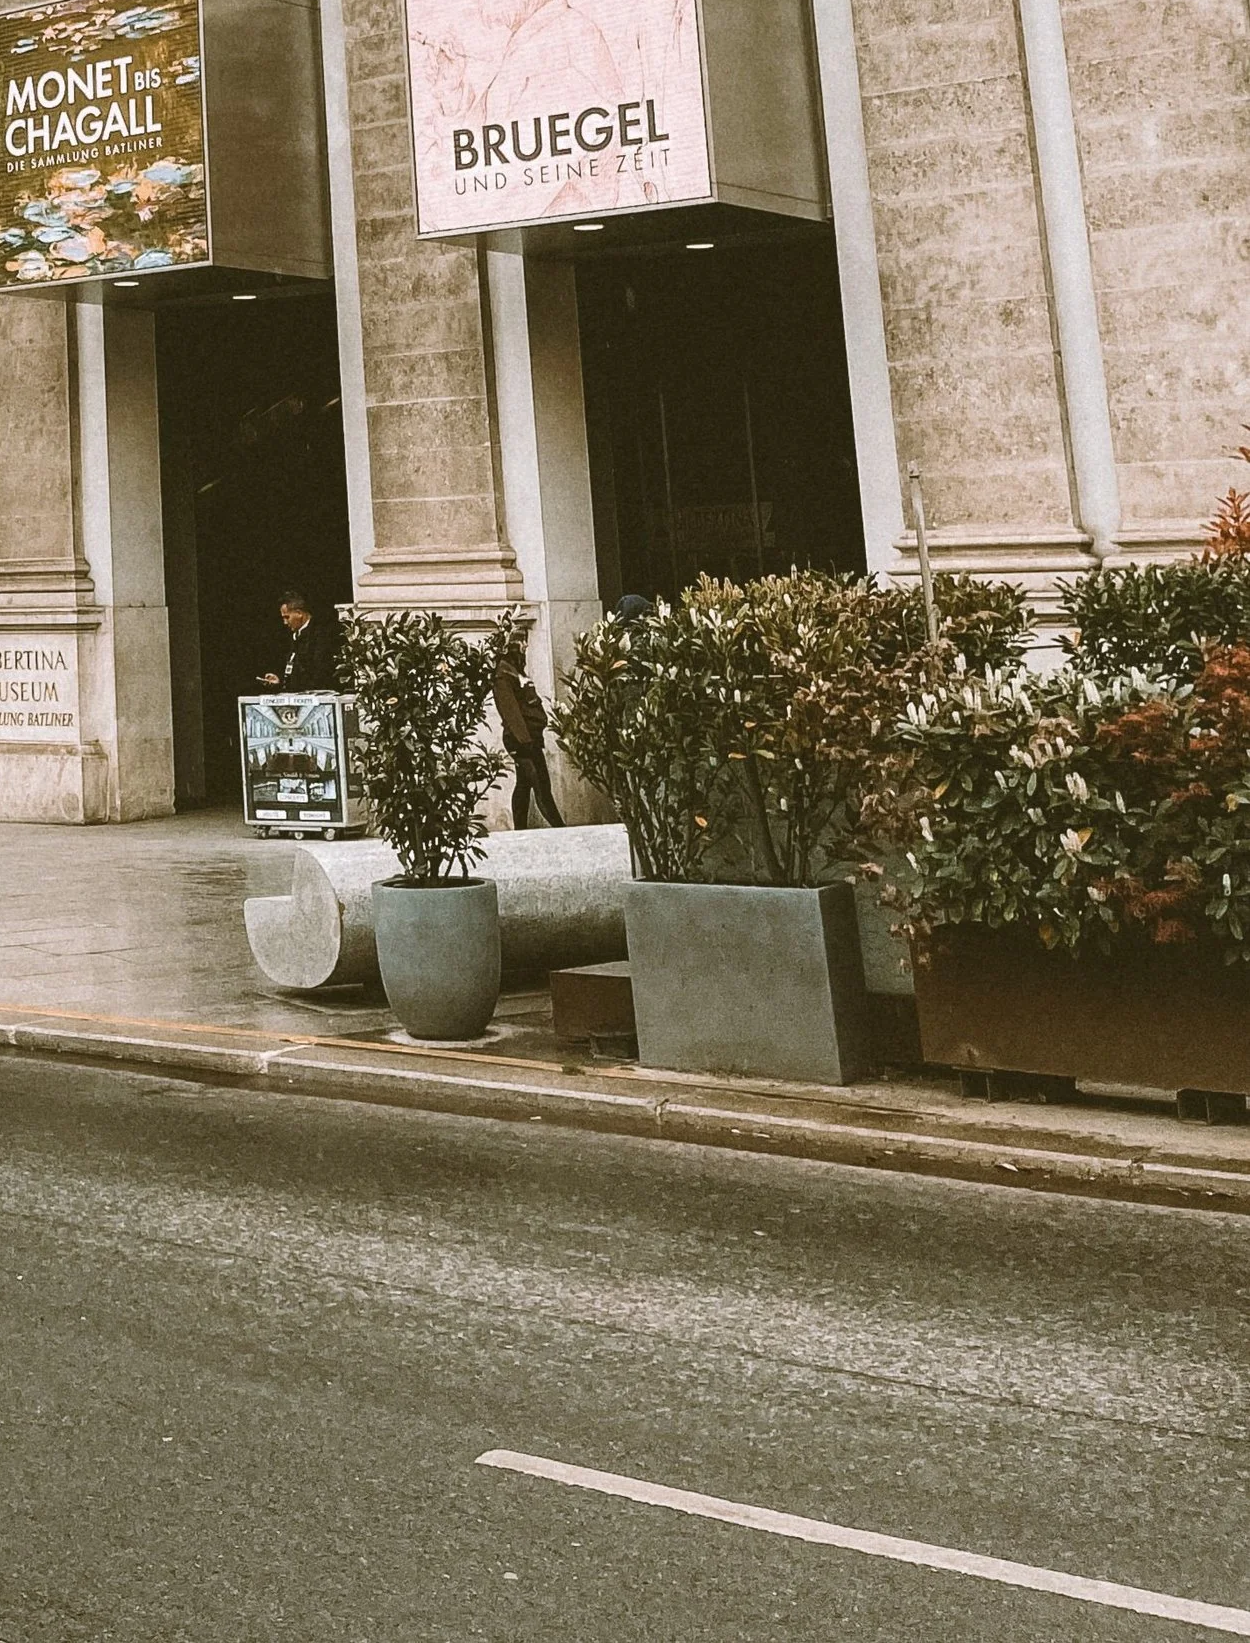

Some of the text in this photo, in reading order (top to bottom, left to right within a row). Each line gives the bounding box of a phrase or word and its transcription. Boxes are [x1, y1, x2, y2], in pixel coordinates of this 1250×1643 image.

[6, 56, 162, 117] MONET BIS
[5, 96, 162, 157] CHAGALL
[453, 99, 669, 171] BRUEGEL
[7, 136, 163, 173] DIE SAMMLUNG BATLINER
[454, 148, 671, 196] UND SEINE ZEIT
[27, 712, 74, 727] BATLINER
